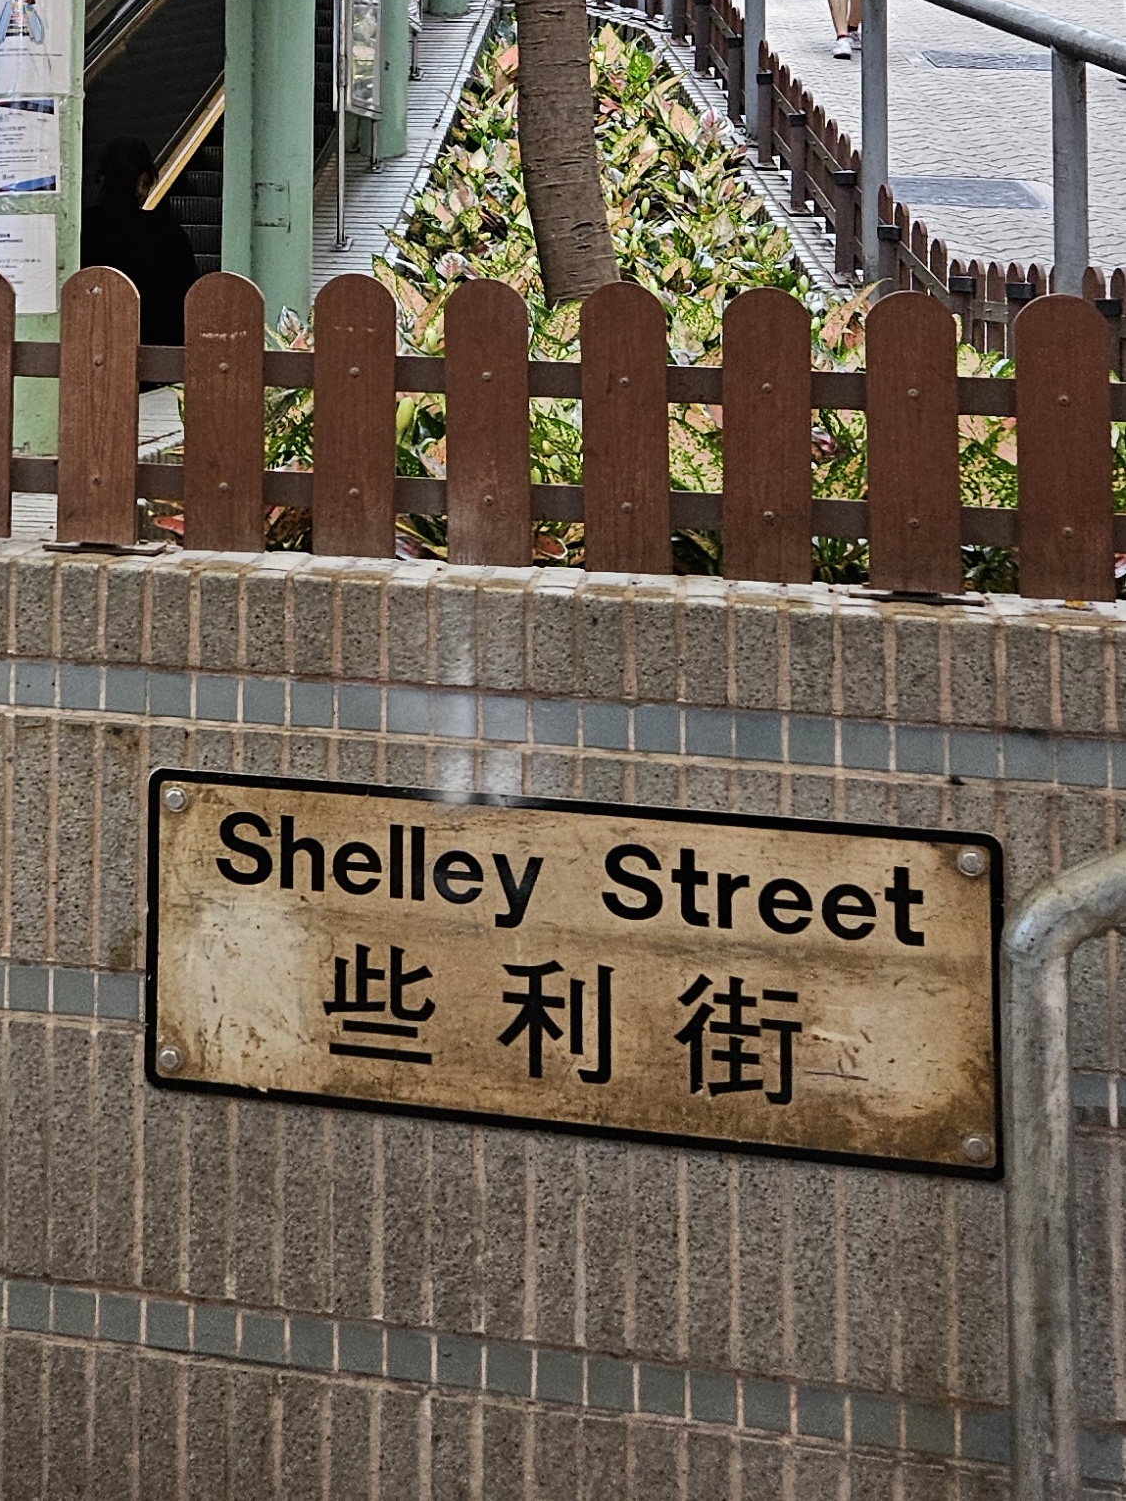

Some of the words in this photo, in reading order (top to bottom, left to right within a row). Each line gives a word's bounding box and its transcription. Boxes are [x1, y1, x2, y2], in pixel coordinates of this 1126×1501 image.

[217, 811, 544, 929] Shelley
[602, 843, 926, 947] Street
[322, 943, 803, 1106] 些利街
